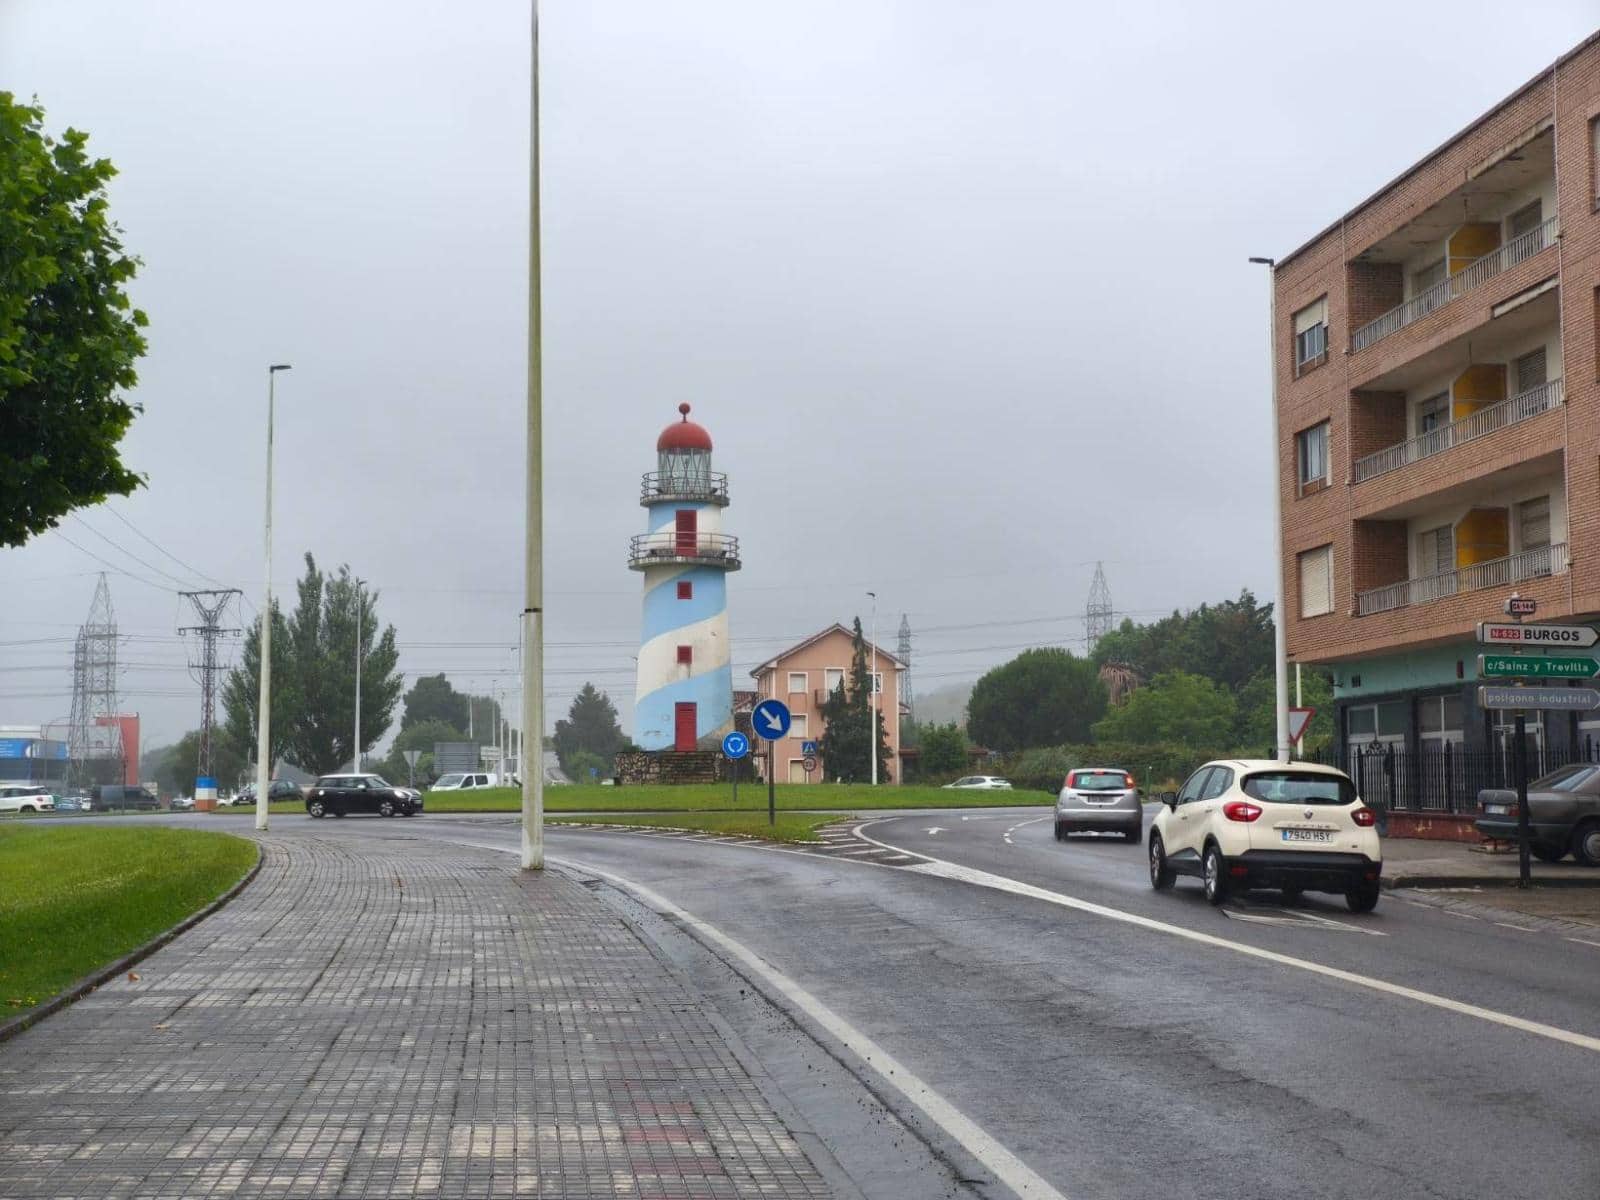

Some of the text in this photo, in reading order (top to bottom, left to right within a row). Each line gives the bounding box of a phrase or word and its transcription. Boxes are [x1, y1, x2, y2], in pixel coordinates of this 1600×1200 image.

[1492, 628, 1580, 641] N-623 BURGOS
[1487, 661, 1528, 671] c/Sainz
[1534, 663, 1540, 672] y
[1288, 831, 1330, 840] 7940 HSY
